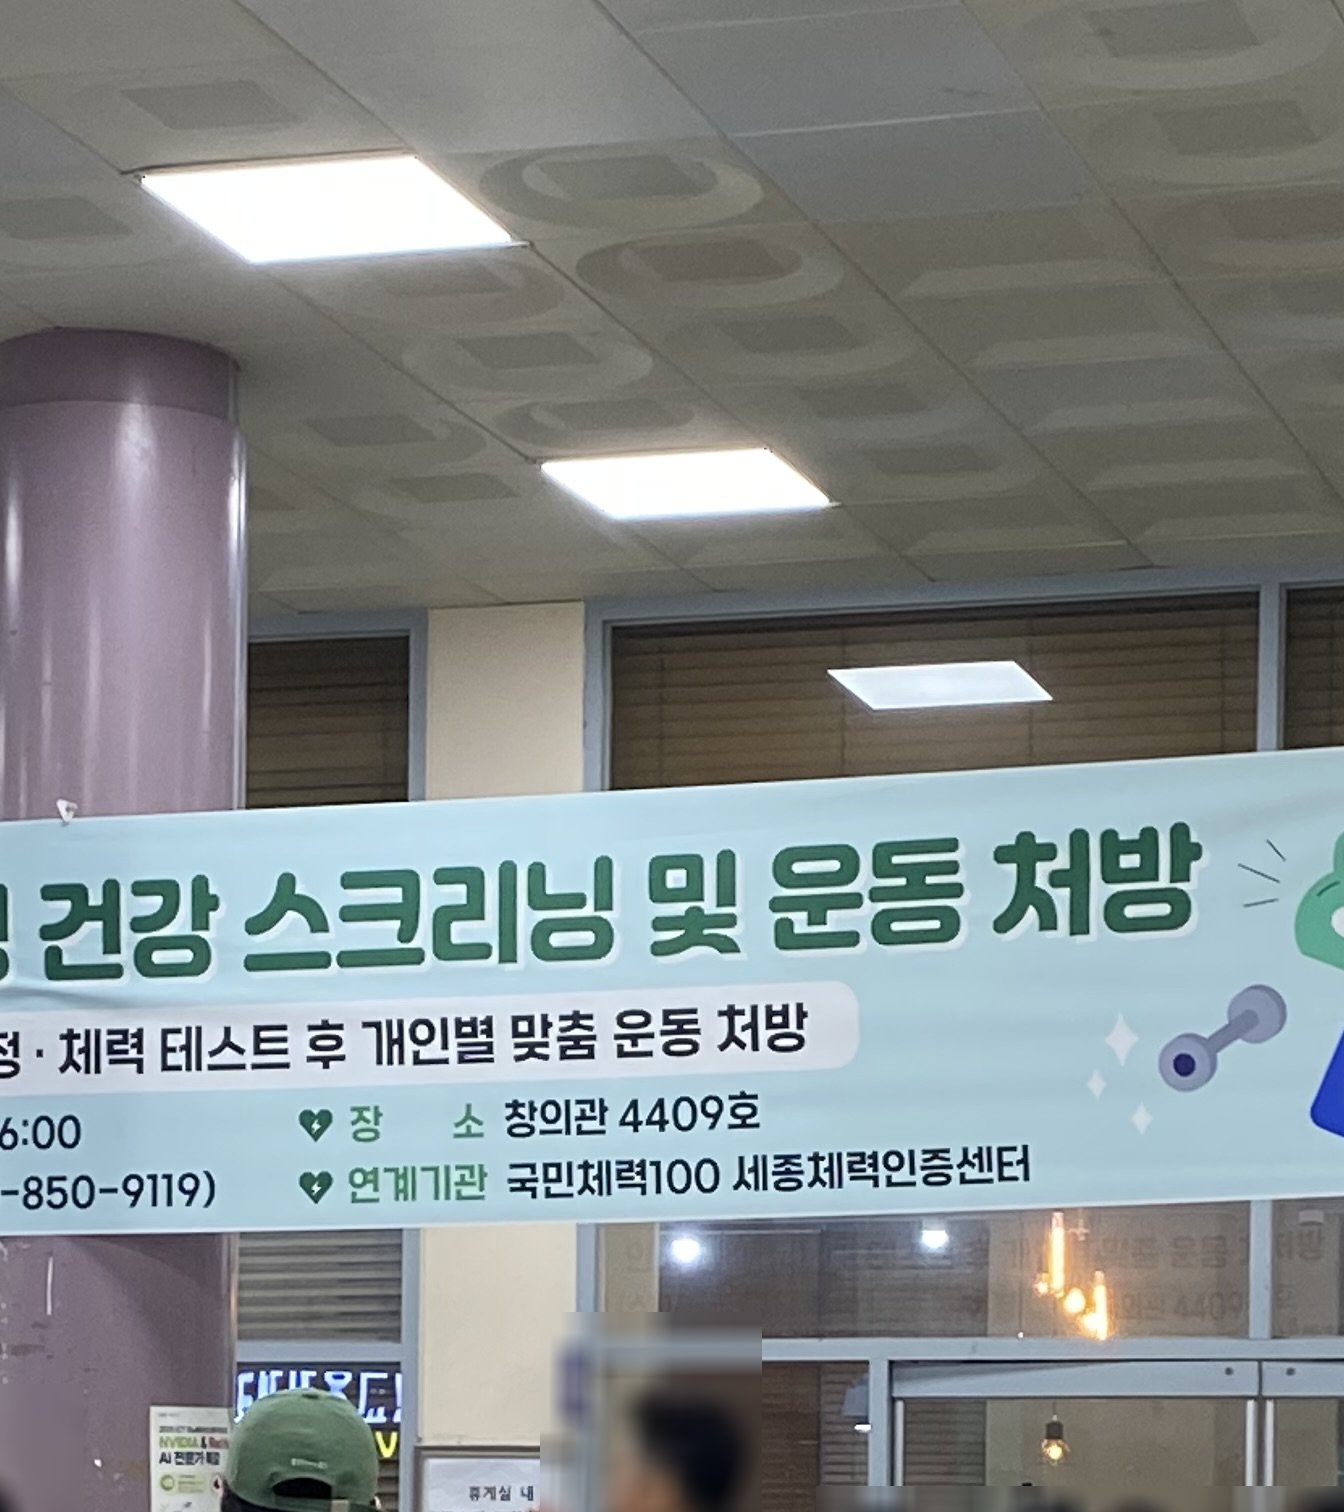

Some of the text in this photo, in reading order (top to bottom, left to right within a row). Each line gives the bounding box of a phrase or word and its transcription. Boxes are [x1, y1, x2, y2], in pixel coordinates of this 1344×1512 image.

[39, 874, 220, 982] 건강
[243, 854, 614, 973] 스크리닝
[647, 849, 742, 958] 및
[768, 836, 964, 951] 운동
[992, 821, 1203, 937] 처방
[58, 1027, 145, 1075] 체력
[160, 1023, 291, 1073] 테스트
[305, 1018, 347, 1070] 후
[361, 1013, 496, 1067] 개인별
[510, 1009, 598, 1063] 맞춤
[612, 1005, 703, 1060] 운동
[716, 1001, 809, 1053] 처방
[504, 1098, 609, 1139] 창의관
[618, 1090, 761, 1133] 4409호
[348, 1143, 1031, 1204] 연계기관 국민체력100 세종체력인증센터
[468, 1485, 512, 1502] 휴게실
